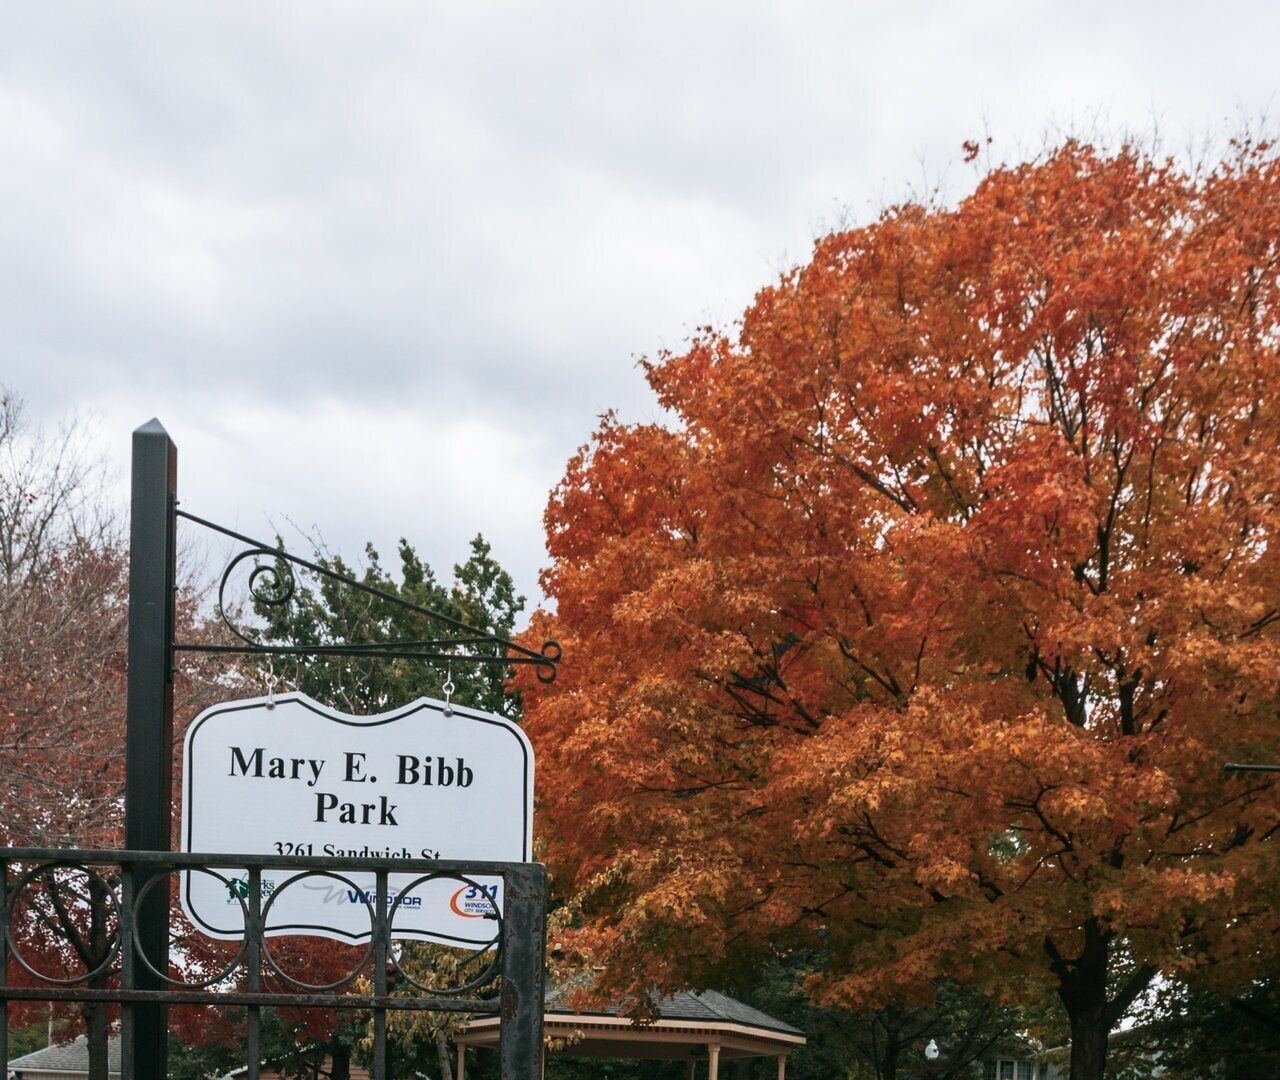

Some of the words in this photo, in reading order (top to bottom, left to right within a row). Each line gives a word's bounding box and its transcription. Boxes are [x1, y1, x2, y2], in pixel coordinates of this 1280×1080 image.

[227, 746, 326, 787] Mary
[342, 751, 378, 783] E.
[395, 755, 474, 788] Bibb
[313, 792, 400, 826] Park
[274, 842, 313, 857] 3261
[323, 844, 412, 859] Sandwich
